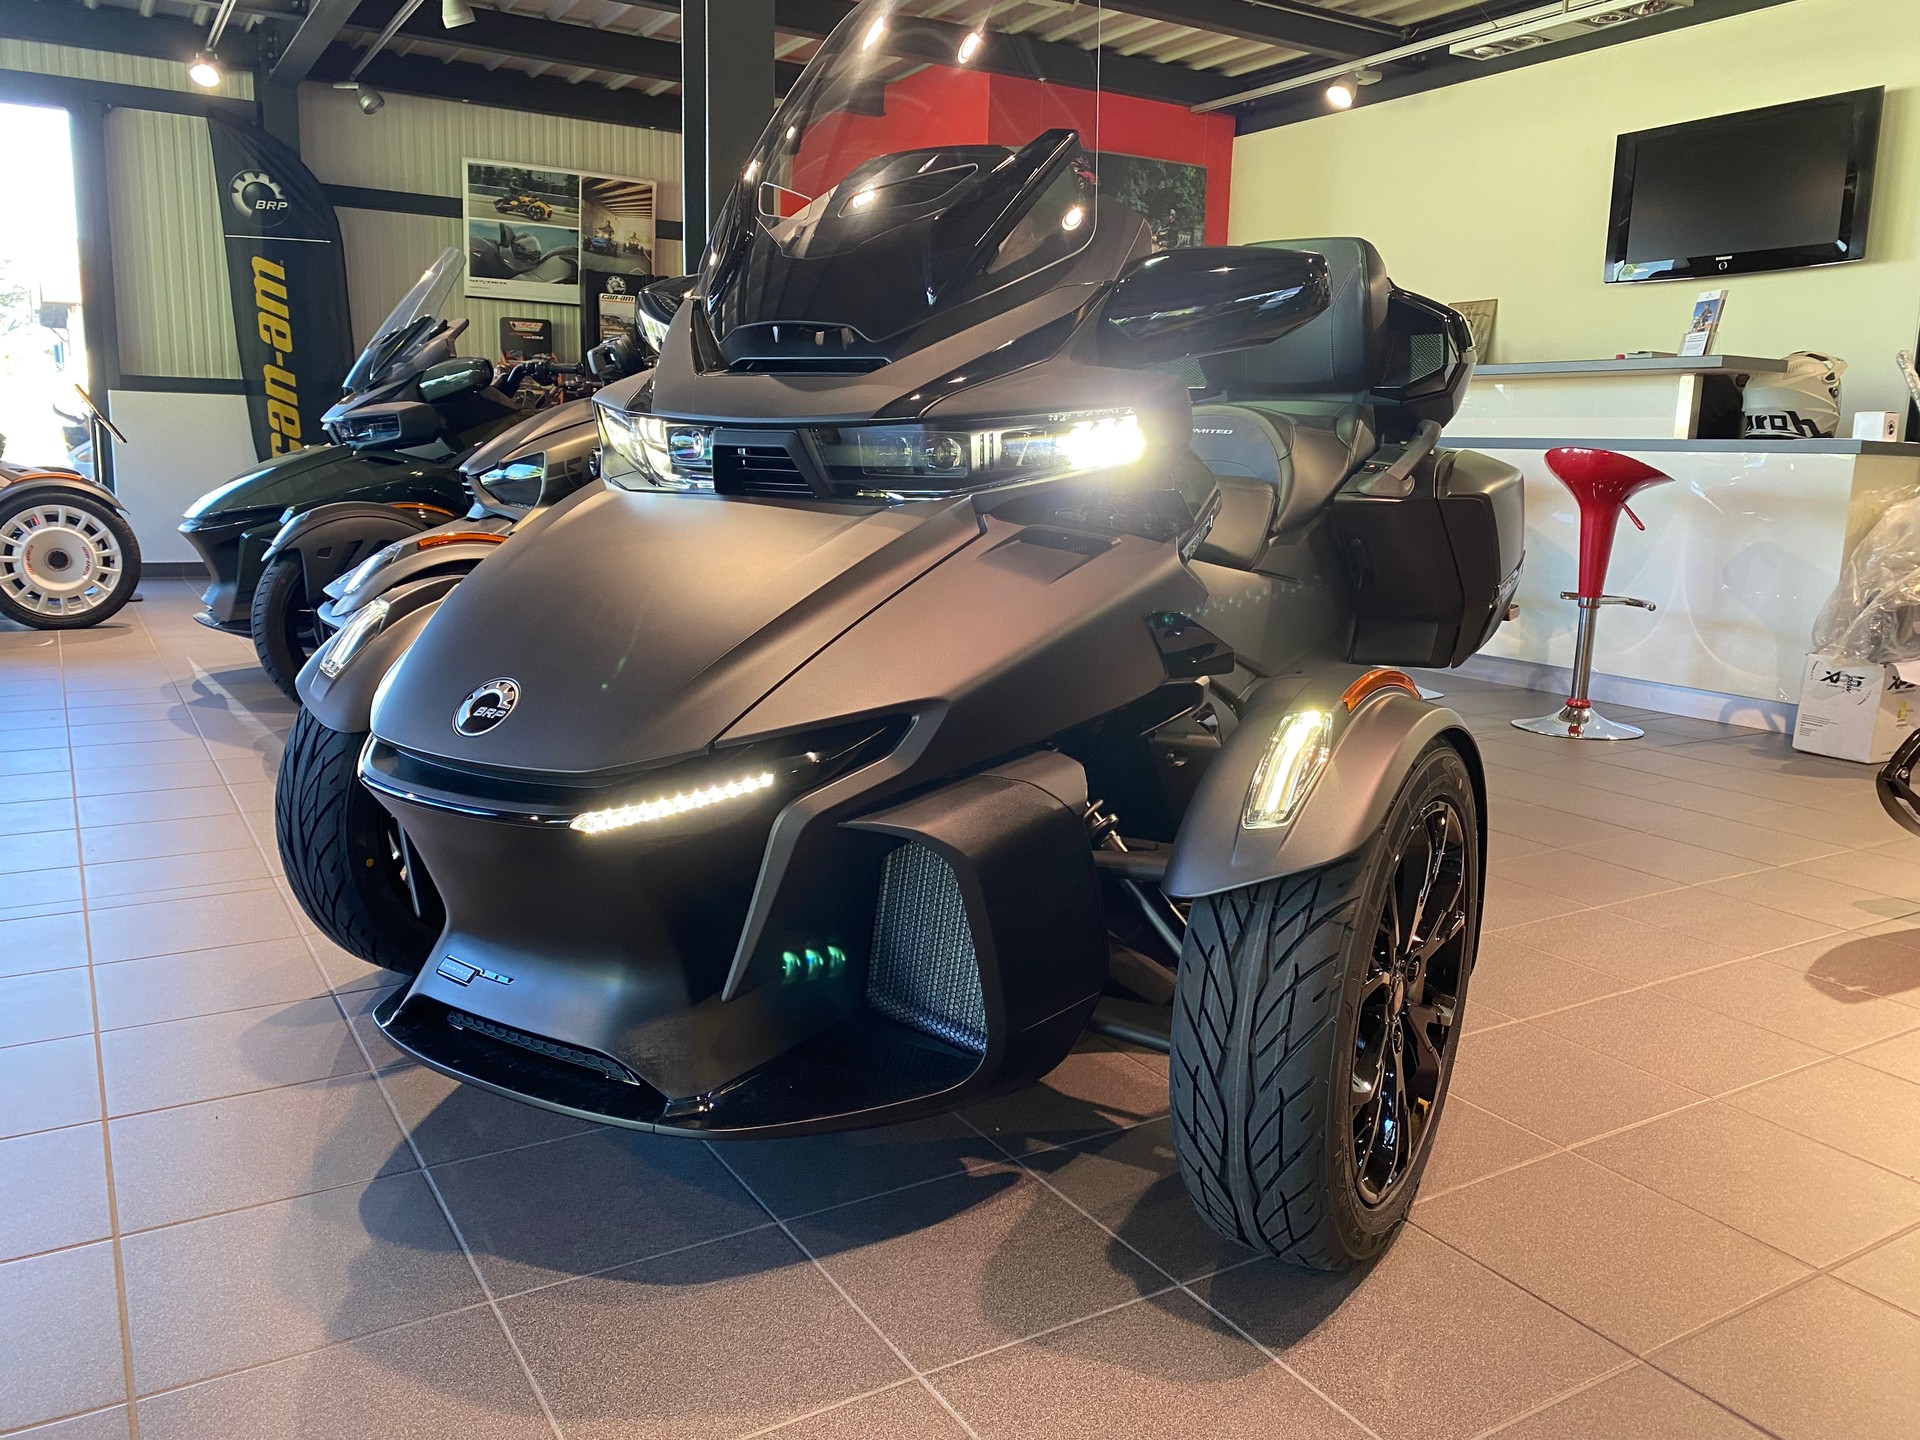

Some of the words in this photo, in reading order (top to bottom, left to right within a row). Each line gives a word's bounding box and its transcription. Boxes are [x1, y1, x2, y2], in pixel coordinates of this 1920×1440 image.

[255, 199, 288, 211] BRP
[602, 294, 634, 302] can-am
[472, 706, 507, 719] BRP
